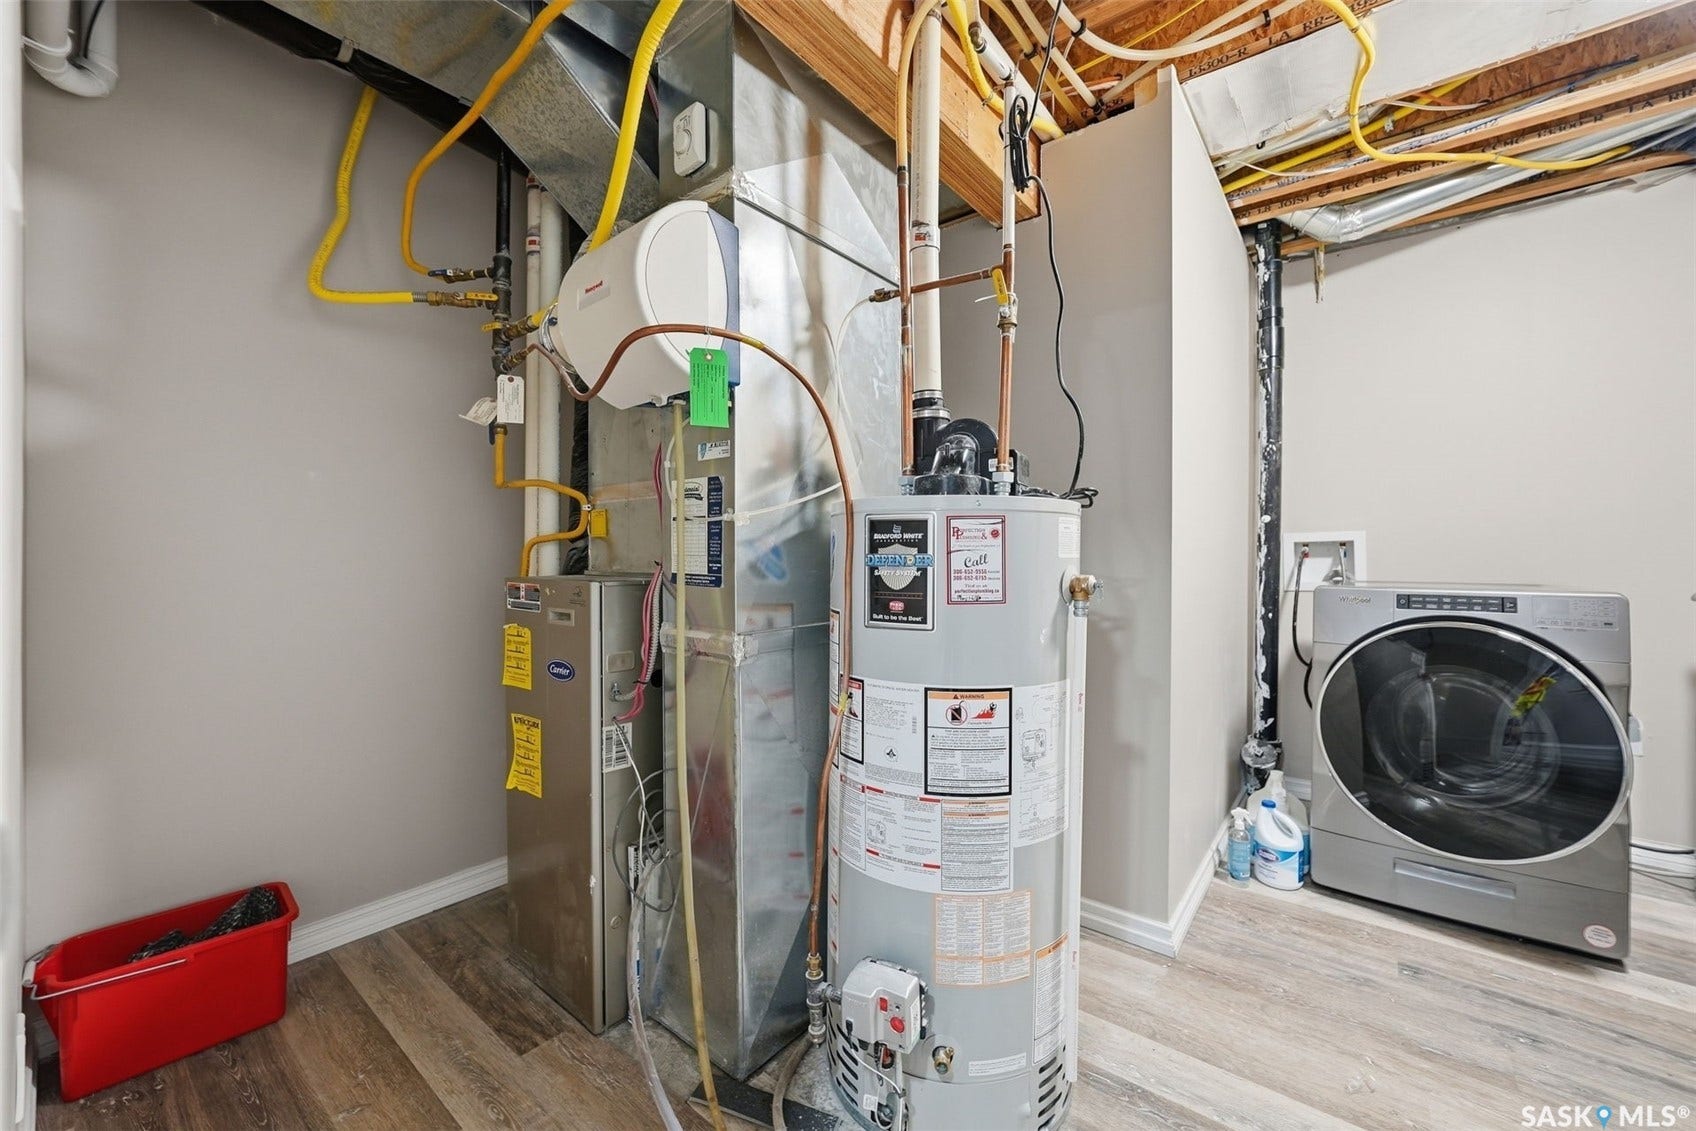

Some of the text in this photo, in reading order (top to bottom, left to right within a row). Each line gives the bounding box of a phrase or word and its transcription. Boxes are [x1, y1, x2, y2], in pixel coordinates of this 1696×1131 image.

[1268, 31, 1291, 46] LA
[1277, 195, 1311, 209] JOIST
[873, 532, 902, 540] BRADFORD
[866, 554, 934, 567] DEFENDER
[964, 553, 988, 568] Call
[1339, 595, 1371, 605] Whirlpool
[549, 664, 570, 676] Carrier
